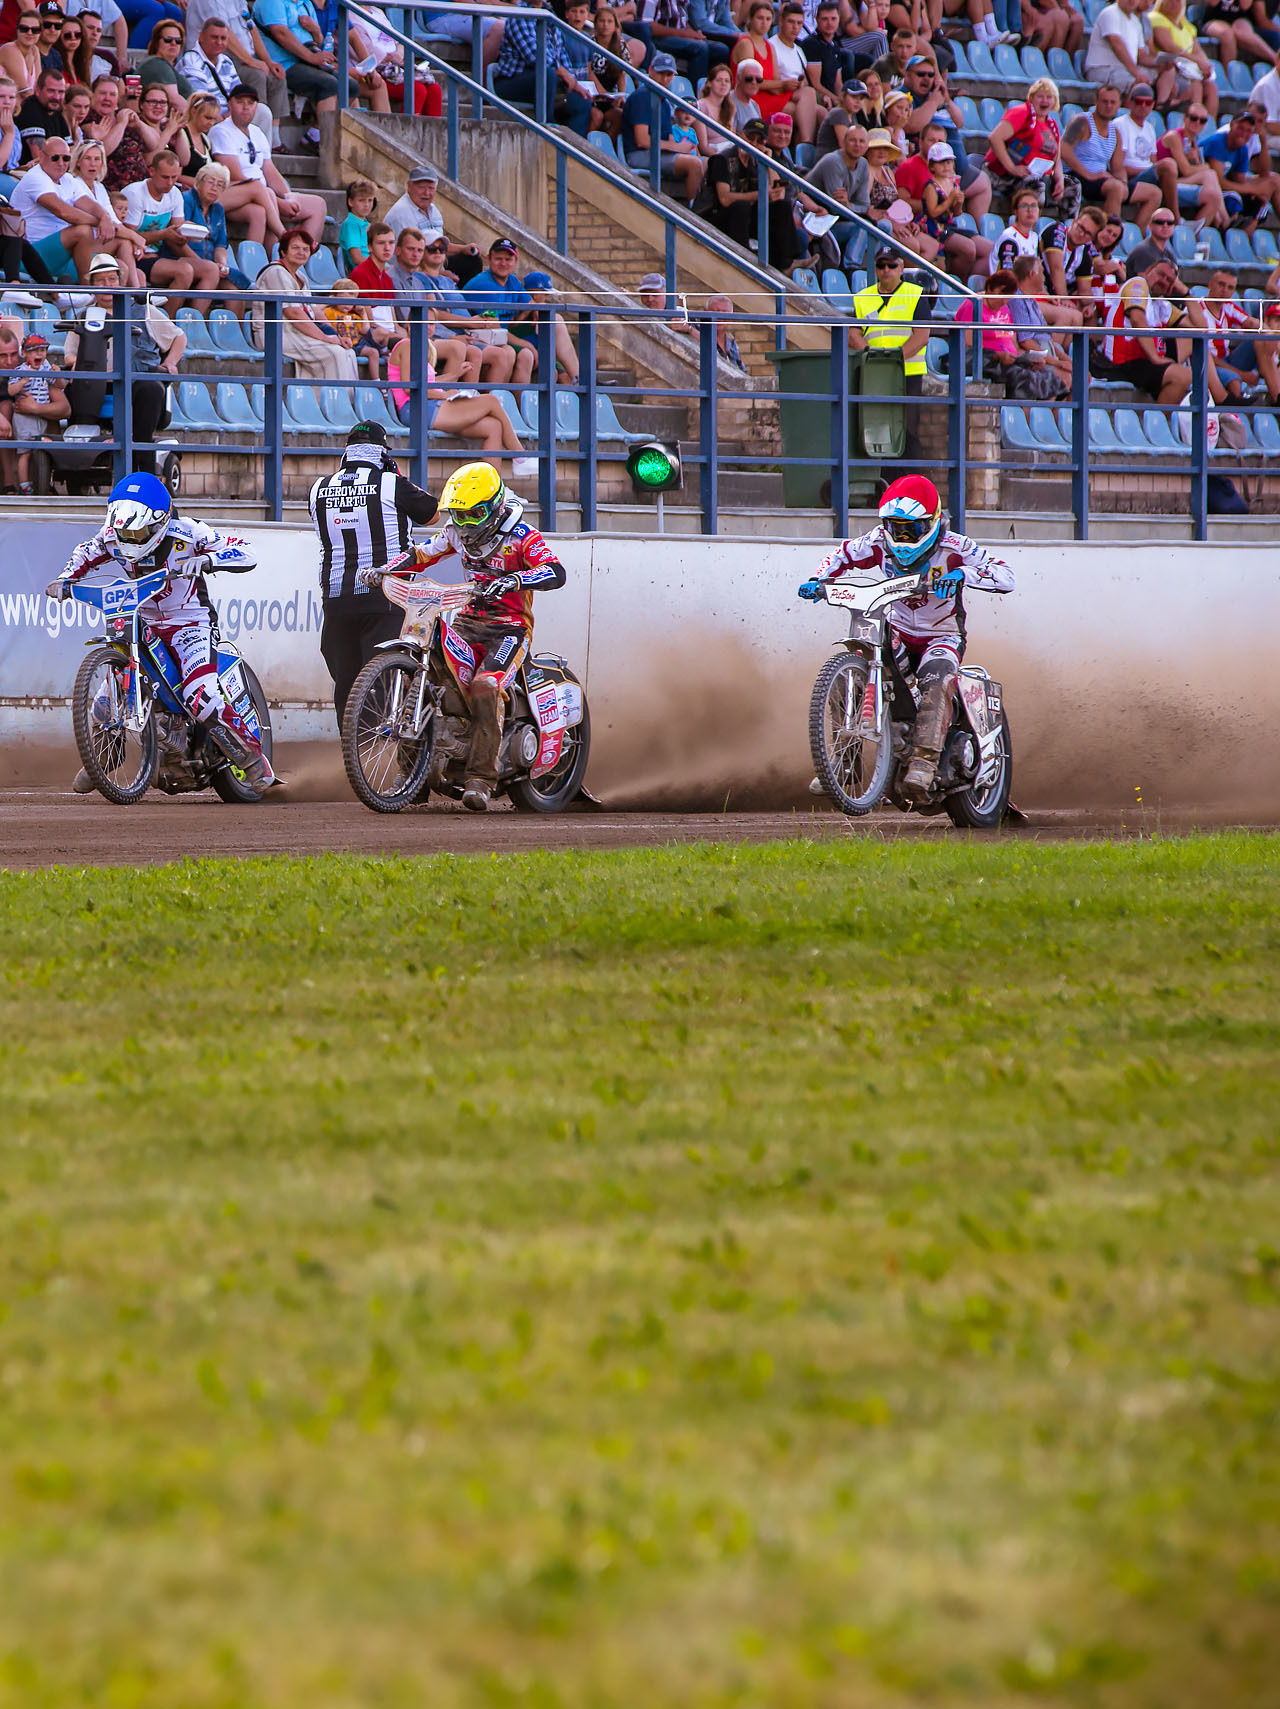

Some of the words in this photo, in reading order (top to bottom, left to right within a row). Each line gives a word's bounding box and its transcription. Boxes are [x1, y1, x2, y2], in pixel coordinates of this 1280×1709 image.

[318, 484, 377, 498] KIEROWNIK
[326, 496, 367, 508] STARTU
[104, 587, 135, 604] GPA
[540, 707, 559, 725] TEAM
